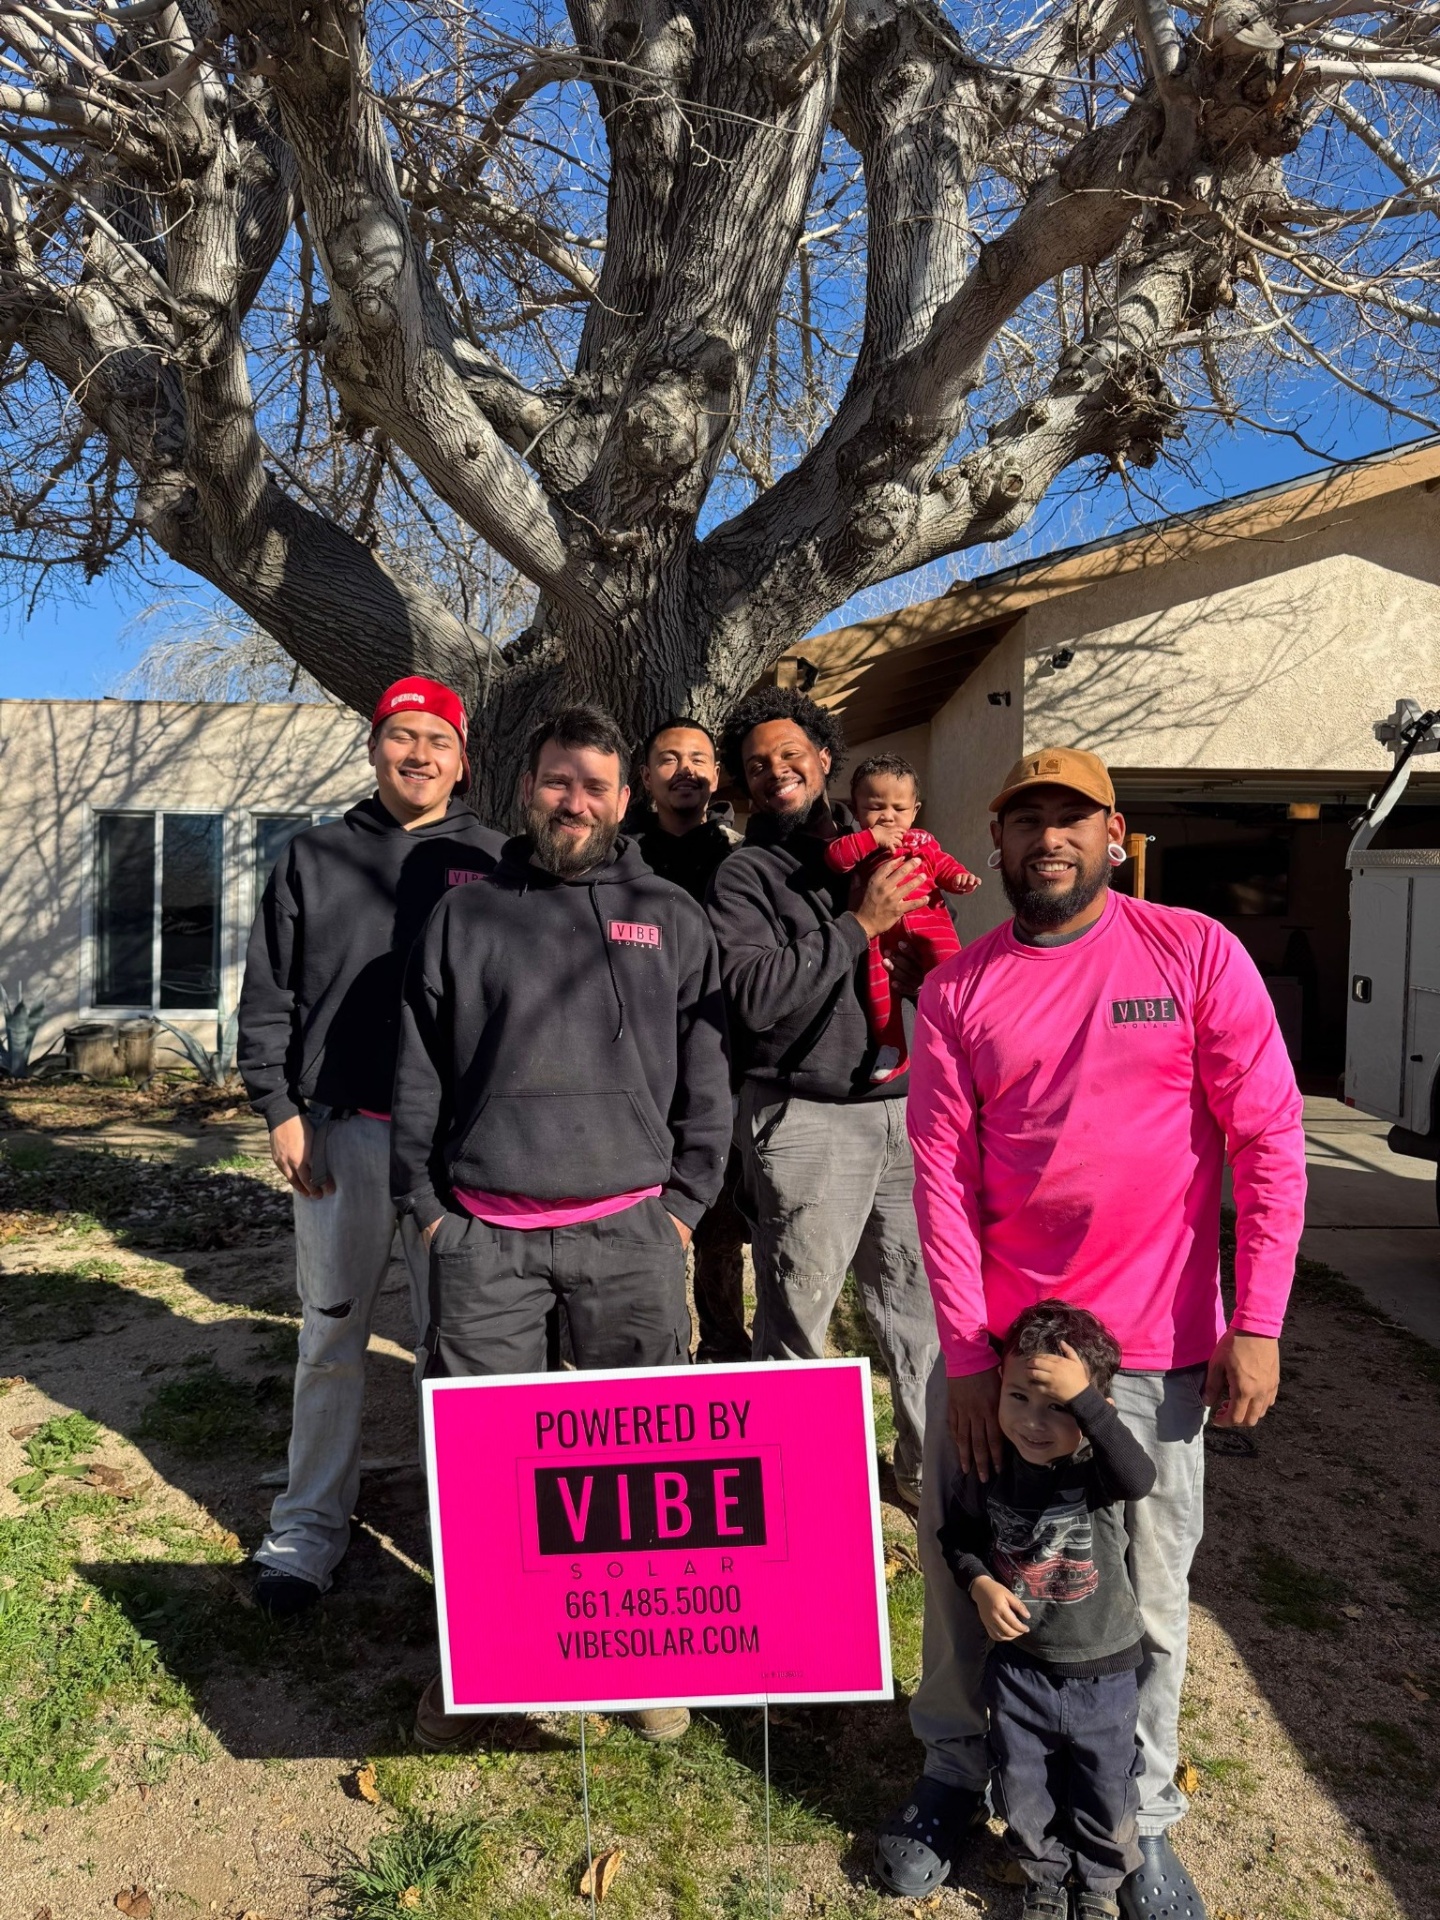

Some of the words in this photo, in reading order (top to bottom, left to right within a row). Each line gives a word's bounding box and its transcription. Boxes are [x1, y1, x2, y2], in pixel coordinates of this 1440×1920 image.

[453, 871, 479, 884] VIB
[617, 924, 655, 942] VIBE
[618, 941, 653, 949] SOLAR
[1118, 1000, 1170, 1020] VIBE
[535, 1403, 696, 1450] POWERED
[708, 1400, 751, 1440] BY
[557, 1468, 744, 1543] VIBE
[569, 1557, 735, 1580] SOLAR
[565, 1585, 741, 1619] 661.485.5000
[557, 1625, 760, 1660] VIBESOLAR.COM
